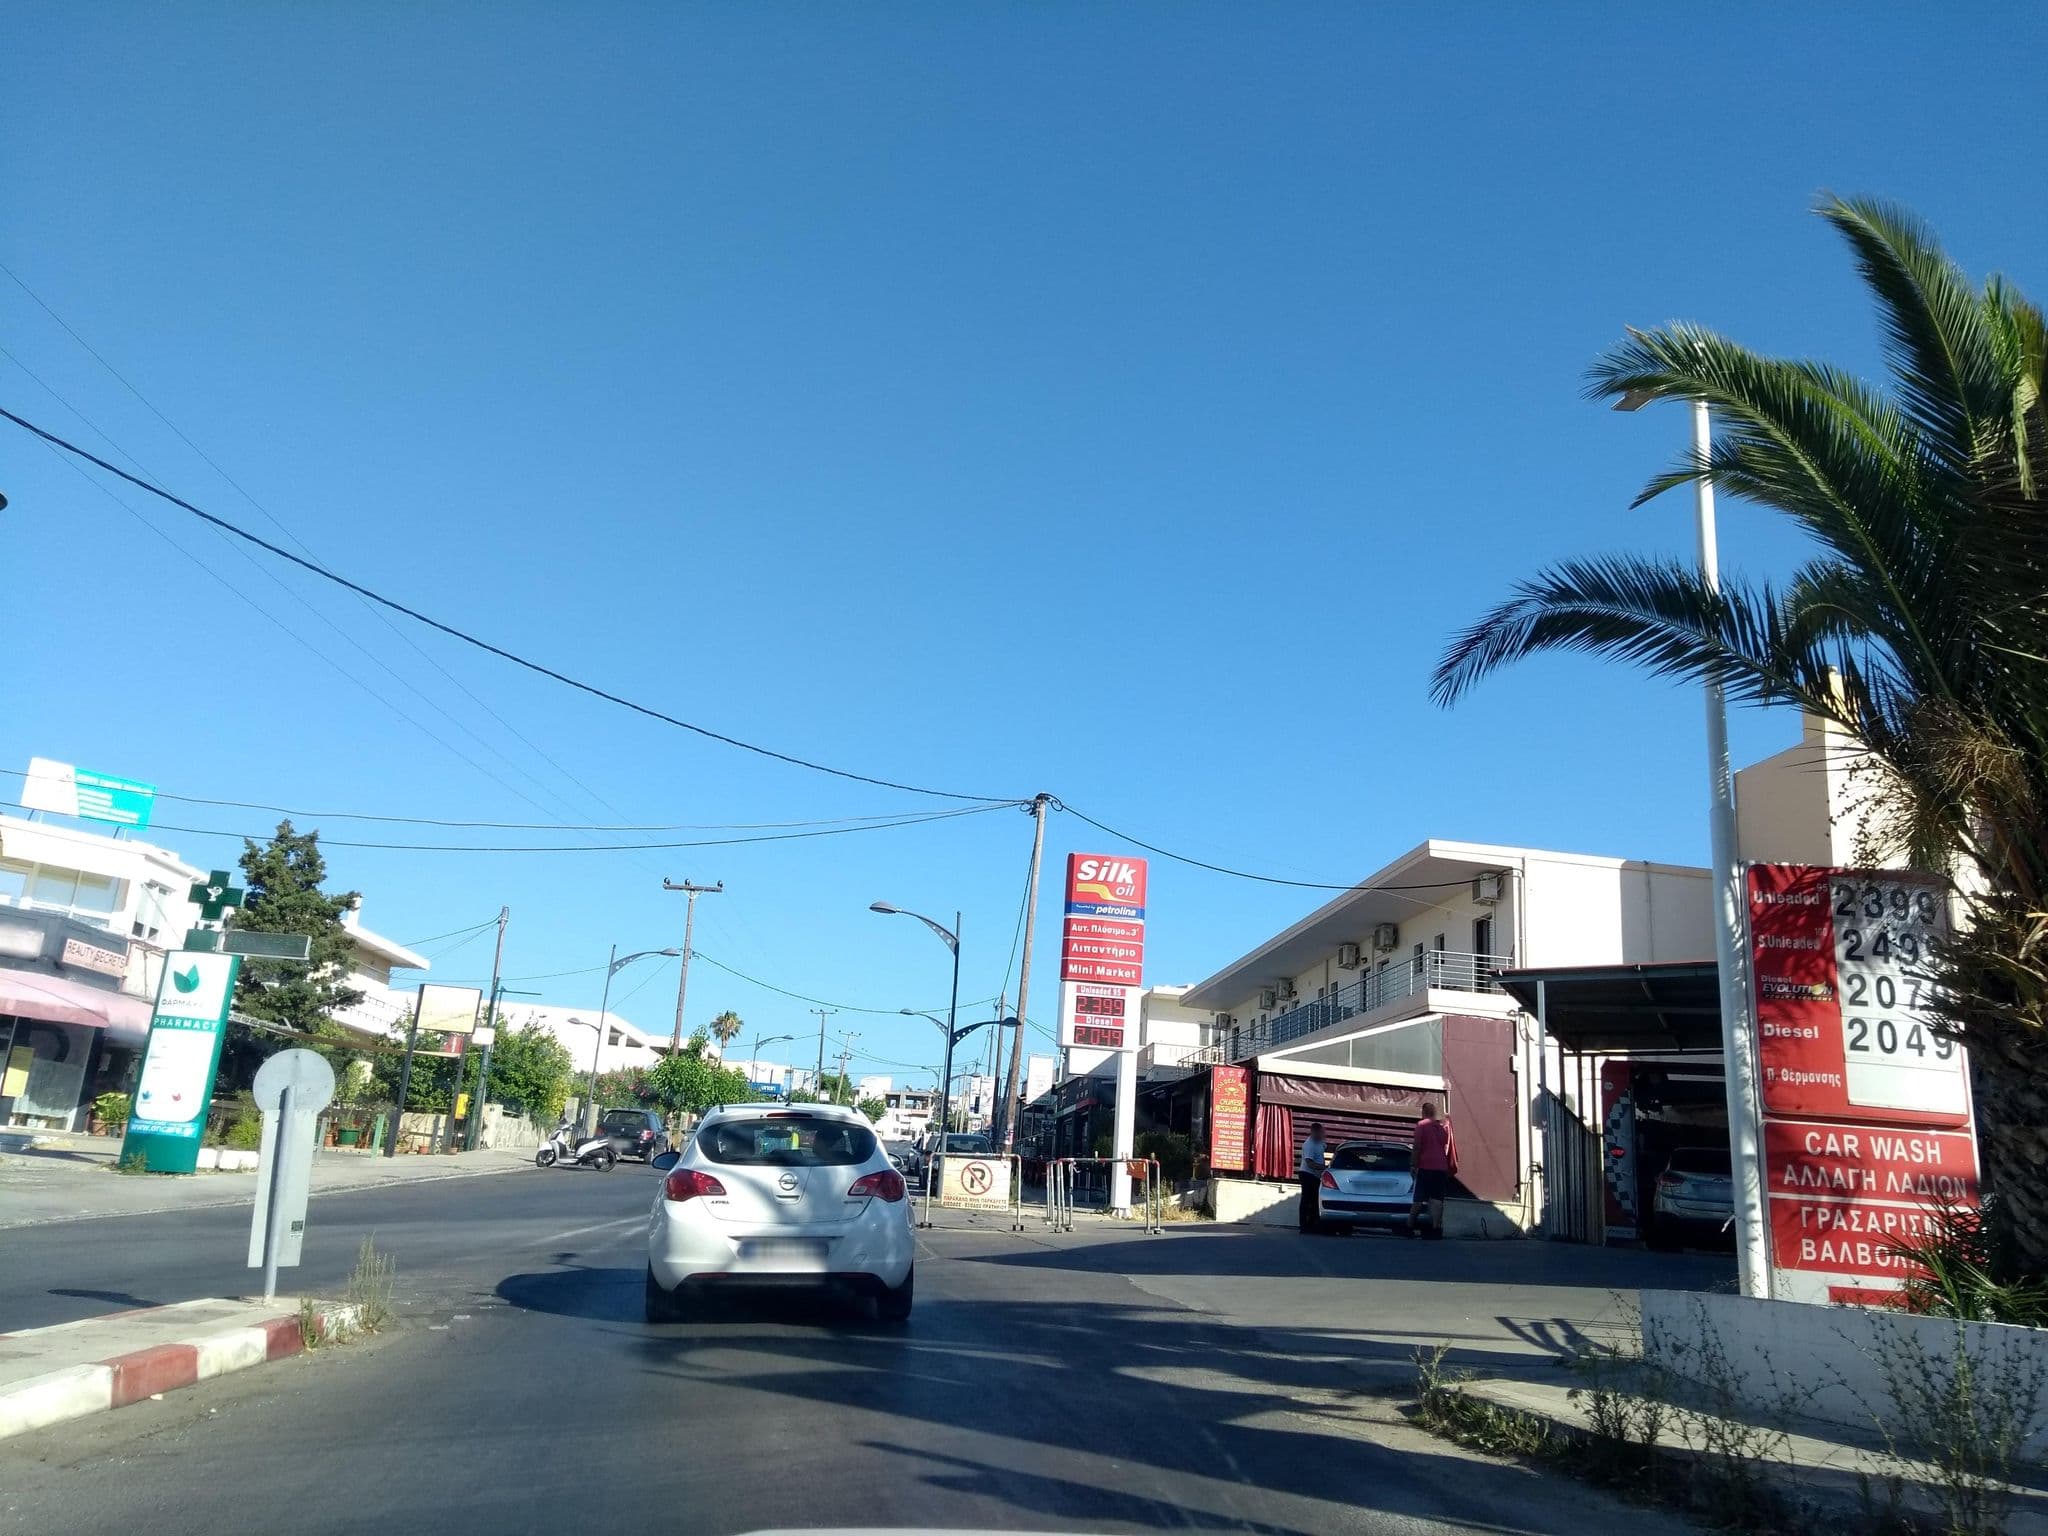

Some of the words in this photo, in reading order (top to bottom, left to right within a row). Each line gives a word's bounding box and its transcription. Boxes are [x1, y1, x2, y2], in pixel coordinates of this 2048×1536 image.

[1077, 860, 1136, 884] Silk
[1116, 885, 1135, 897] oil
[1753, 890, 1820, 905] Unleaded
[1816, 884, 1829, 893] 95
[67, 938, 94, 959] BEAUTY
[94, 952, 127, 970] SECRETS
[1072, 943, 1136, 957] Λιπαντήριο
[1068, 964, 1093, 974] Mini
[1096, 965, 1136, 979] Market
[153, 1017, 218, 1031] PHARMACY
[1085, 1016, 1113, 1026] Diesel
[1764, 1023, 1820, 1039] Diesel
[1848, 1018, 1954, 1060] 2049
[1781, 1068, 1841, 1088] Θέρμανσης
[1804, 1131, 1861, 1158] CAR
[1869, 1136, 1942, 1164] WASH
[1783, 1164, 1876, 1191] ΑΛΛΑΓΗ
[1885, 1171, 1967, 1199] ΛΑΔΙΩΝ
